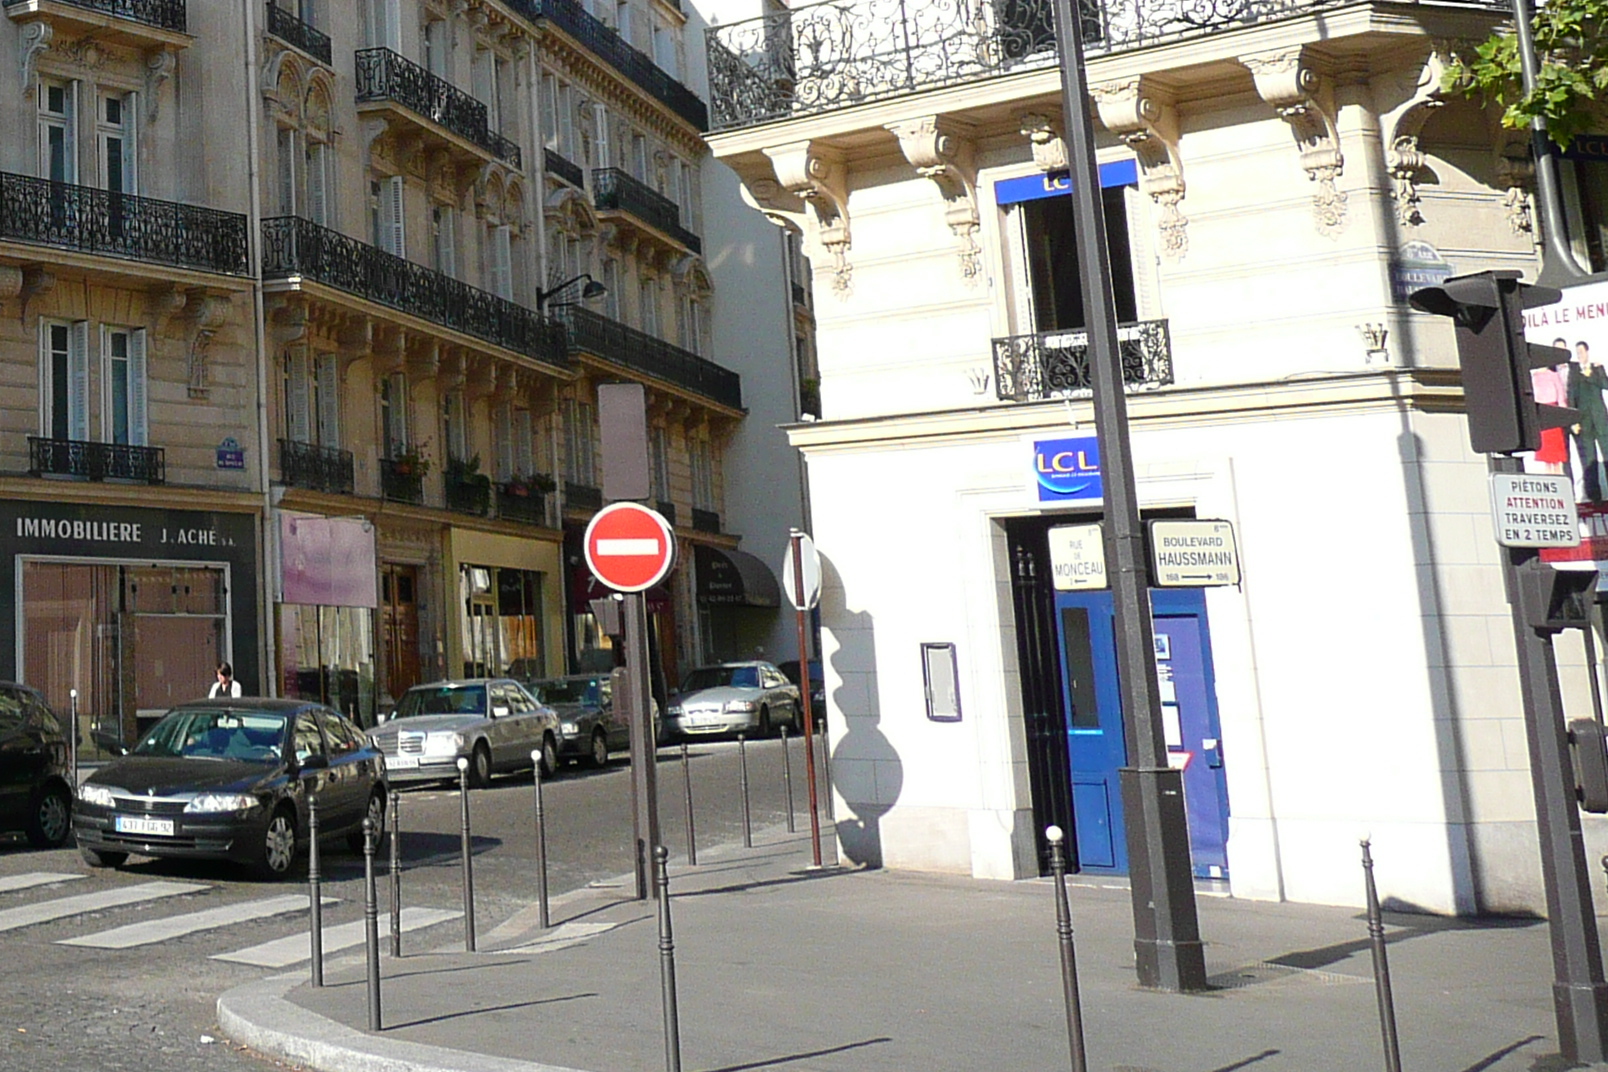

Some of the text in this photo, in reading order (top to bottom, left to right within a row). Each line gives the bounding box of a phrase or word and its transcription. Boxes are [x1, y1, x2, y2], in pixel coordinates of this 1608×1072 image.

[1555, 308, 1570, 324] LE
[1576, 302, 1608, 321] MEN
[1037, 450, 1098, 473] LCL
[1507, 496, 1565, 509] ATTENTION
[1505, 512, 1569, 525] TRAVERSEZ
[16, 517, 142, 543] IMMOBILIERE
[1505, 528, 1573, 541] EN 2 TEMPS
[1069, 539, 1083, 550] RUE
[1163, 537, 1223, 547] BOULEVARD
[1158, 551, 1232, 567] HAUSSMANN
[1055, 561, 1103, 578] MONCEAU
